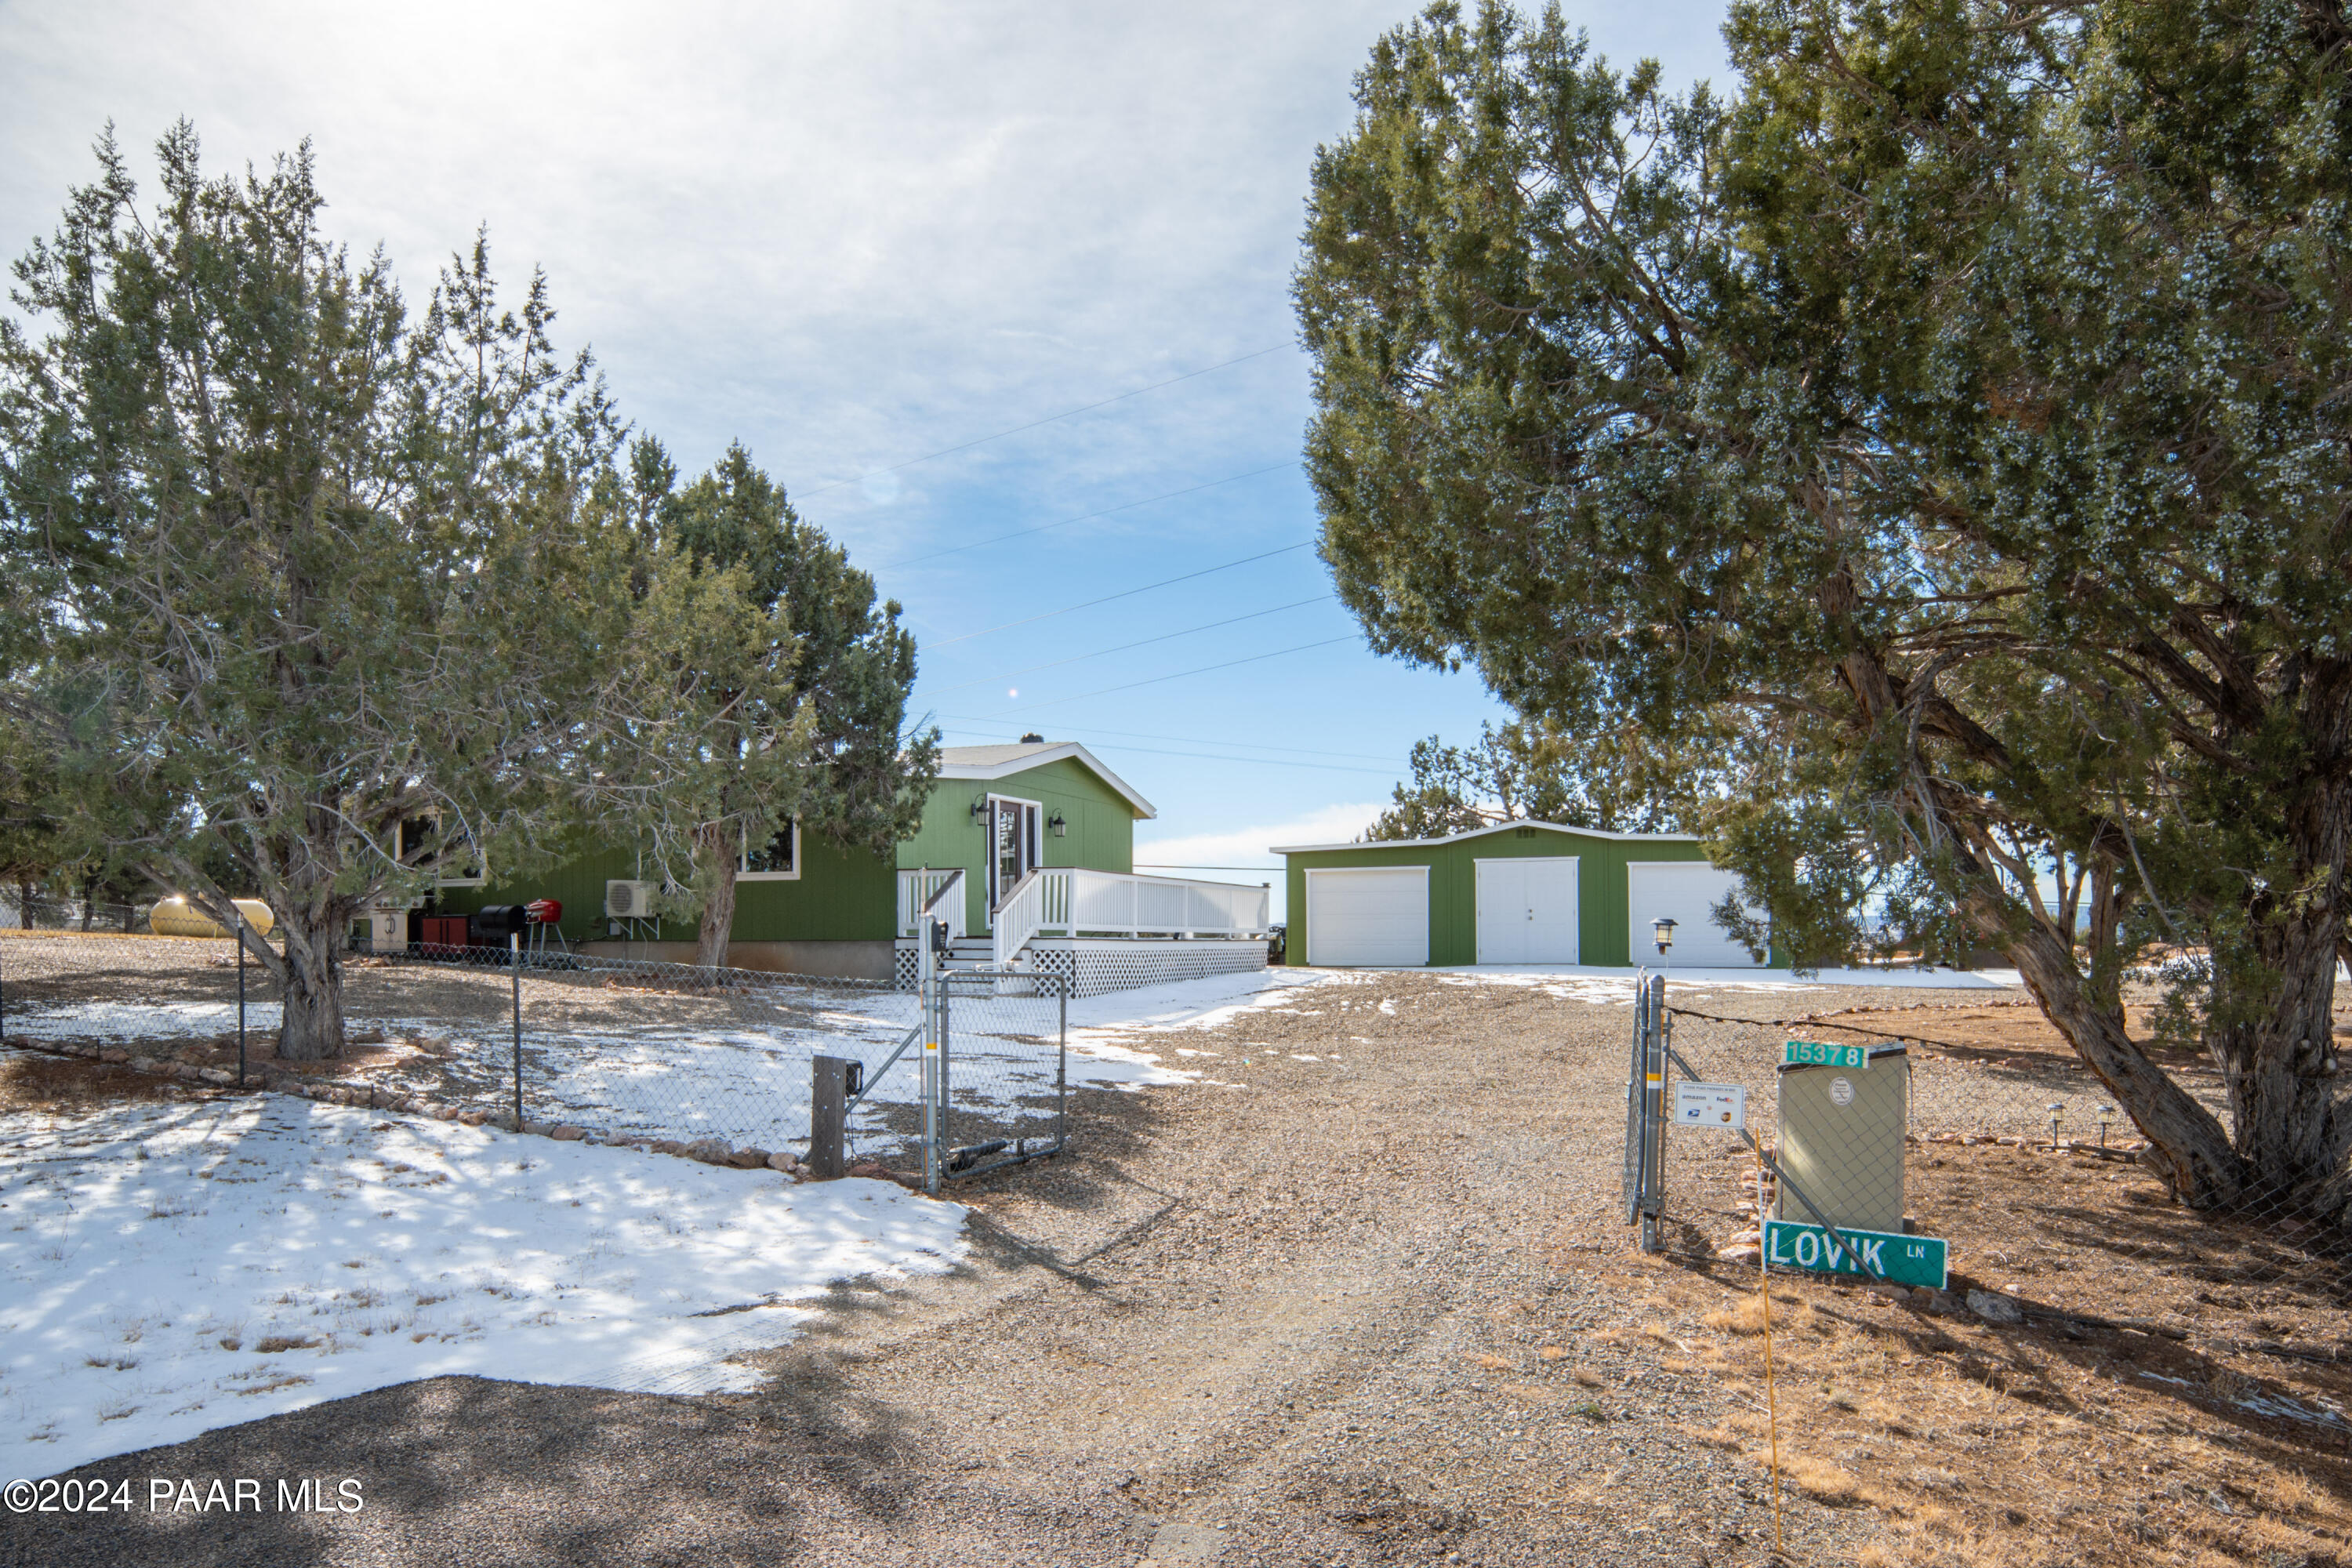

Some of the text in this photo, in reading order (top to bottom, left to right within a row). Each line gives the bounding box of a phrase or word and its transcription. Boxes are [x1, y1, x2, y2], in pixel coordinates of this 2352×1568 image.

[1788, 1043, 1859, 1066] 15378
[1769, 1228, 1925, 1276] LOVIK LN
